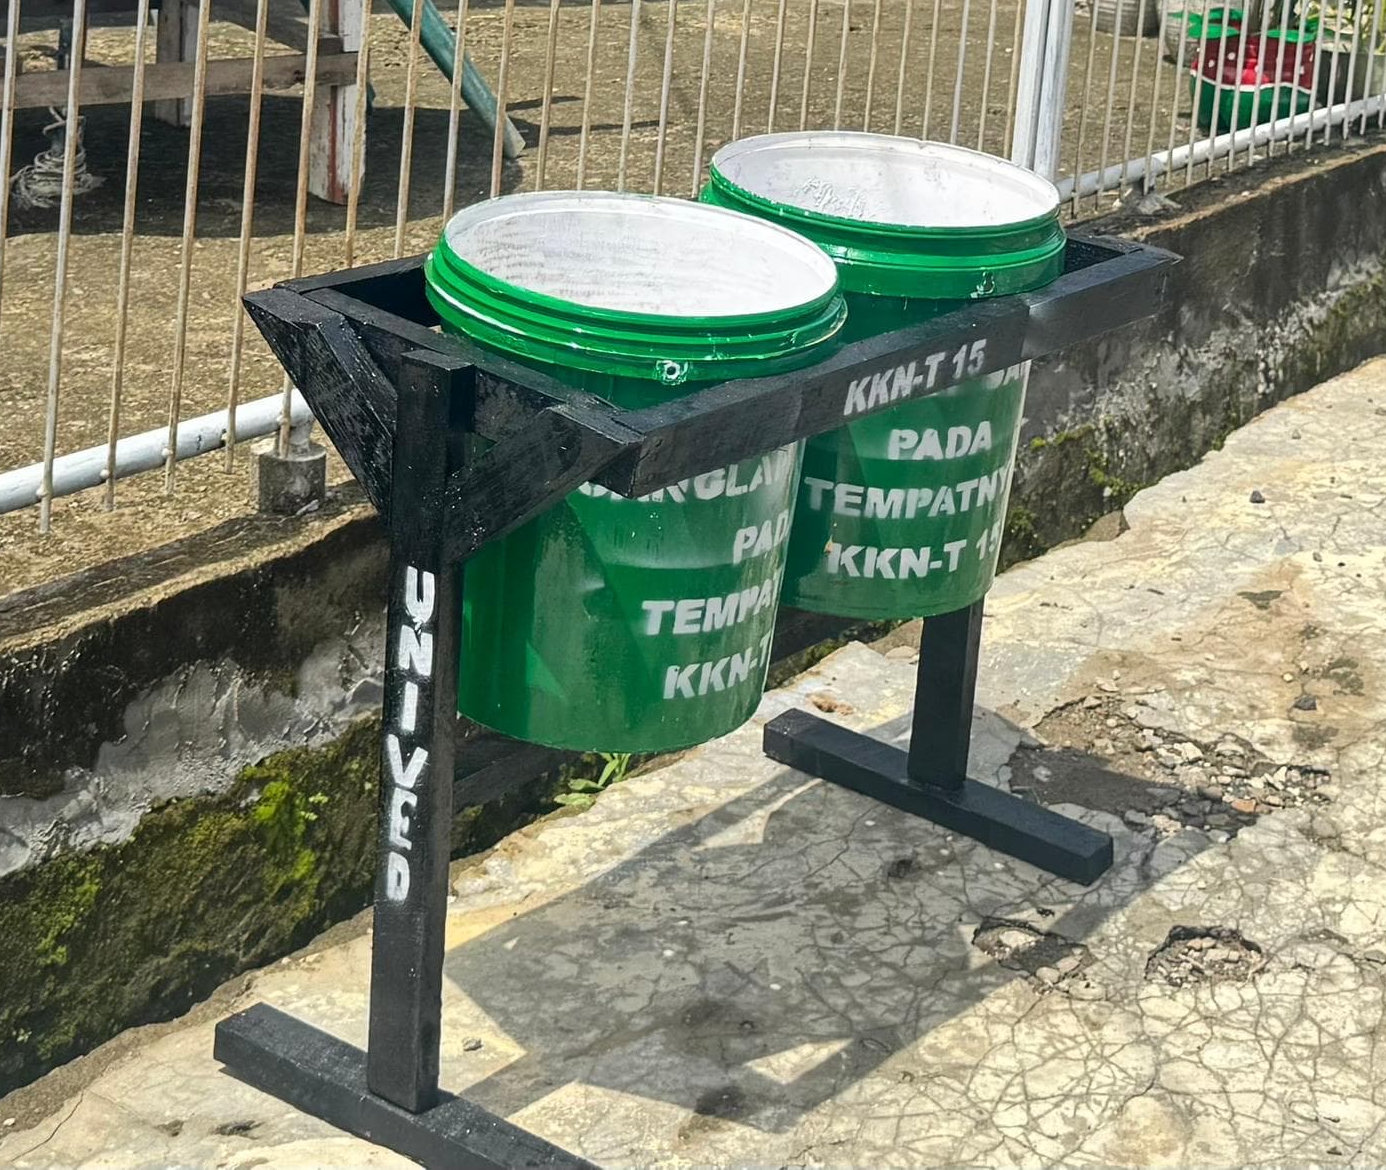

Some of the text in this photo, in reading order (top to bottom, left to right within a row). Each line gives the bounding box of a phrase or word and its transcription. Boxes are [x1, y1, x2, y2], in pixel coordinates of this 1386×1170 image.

[843, 351, 946, 416] KKN-T
[952, 338, 988, 380] 15
[888, 420, 993, 461] PADA
[826, 539, 967, 580] KKN-T
[386, 564, 436, 902] UNIVED
